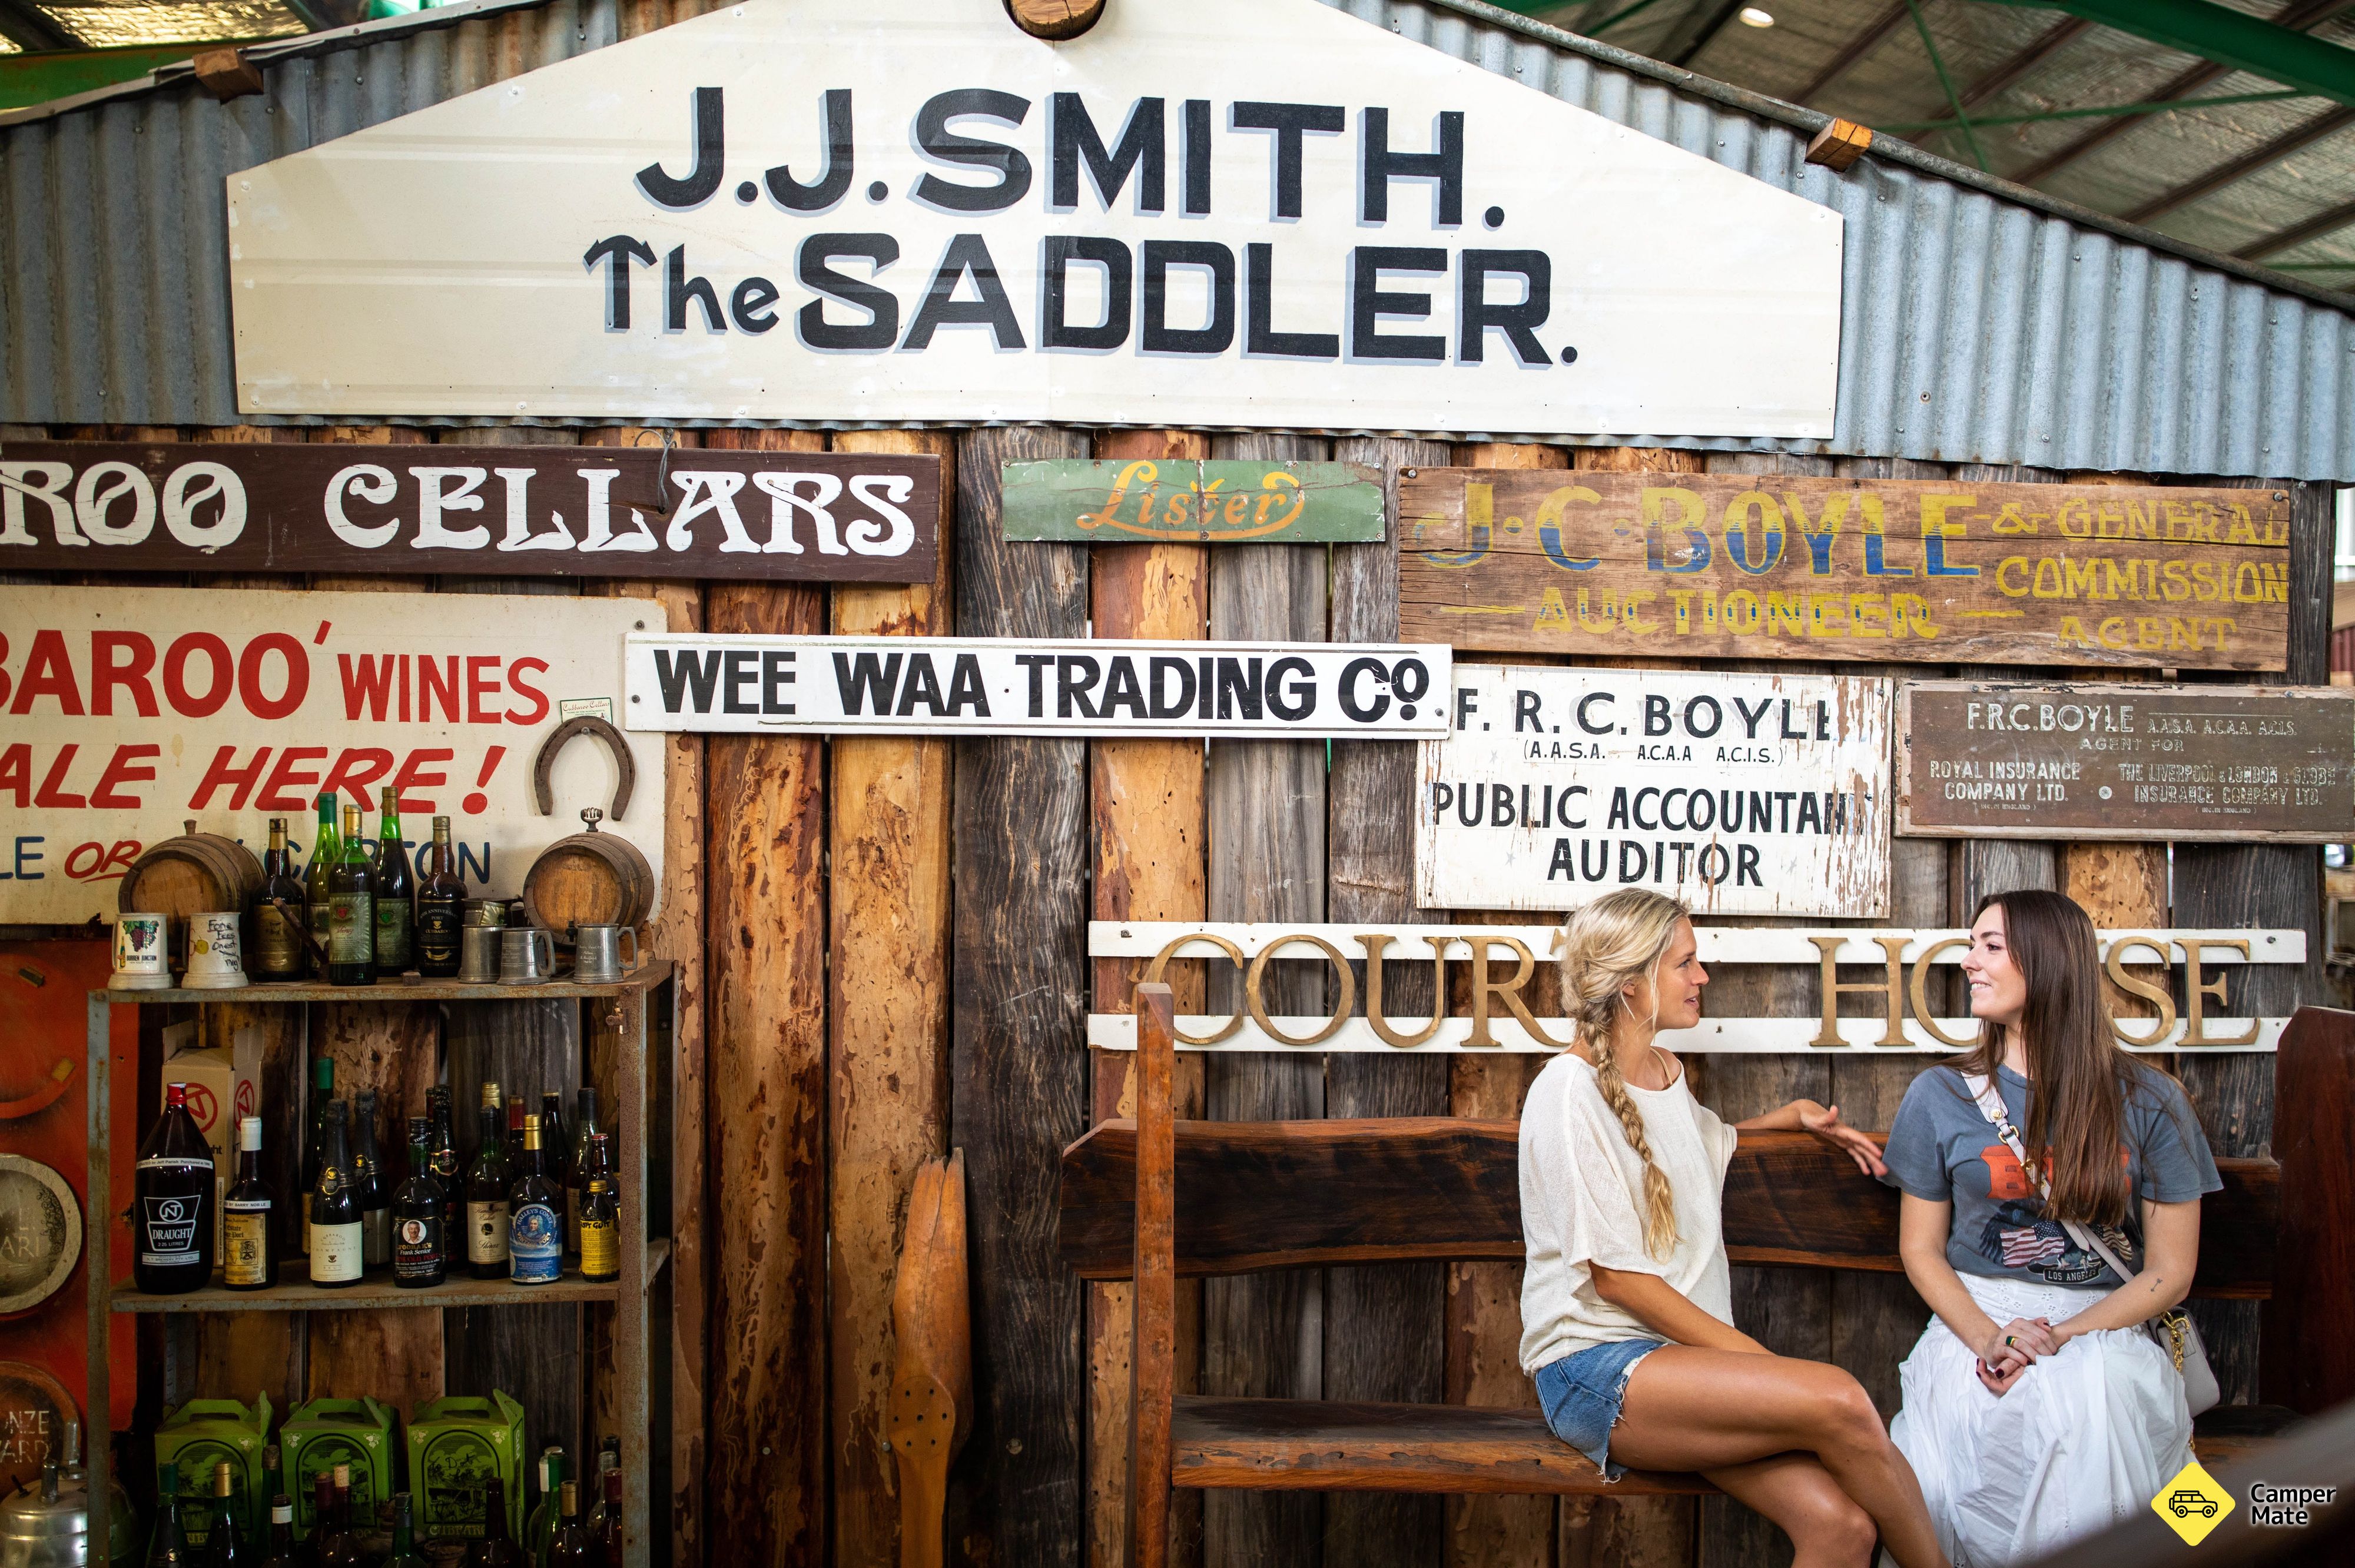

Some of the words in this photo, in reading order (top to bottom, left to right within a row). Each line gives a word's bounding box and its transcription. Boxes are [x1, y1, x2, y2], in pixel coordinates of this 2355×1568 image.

[583, 234, 781, 334] The
[796, 232, 1579, 366] SADDLER.
[324, 463, 915, 557] CELLARS
[1077, 460, 1305, 540] Lister
[2058, 497, 2288, 546] GENERAL
[1996, 556, 2288, 603] COMMISSION
[1532, 586, 1942, 639] AUCTIONEER
[2059, 616, 2237, 652] AGENT
[0, 620, 331, 720] AROO'
[338, 653, 550, 726] WINES
[653, 649, 796, 715] WEE
[831, 652, 991, 717] WAA
[1014, 654, 1317, 720] TRADING
[2079, 738, 2142, 751] AGENT
[2151, 739, 2185, 752] FOR
[1930, 760, 1983, 779] ROYAL
[1989, 761, 2081, 780] INSURANCE
[1944, 782, 2029, 801] COMPANY
[2036, 782, 2069, 802] LTD.
[2118, 763, 2144, 782] THE
[2148, 764, 2216, 783] LIVERPOOL
[2228, 766, 2278, 784] LONDON
[2293, 766, 2336, 787] GLOBE
[1432, 782, 1588, 829] PUBLIC
[1608, 786, 1872, 835] ACCOUNTAN
[2134, 785, 2214, 804] INSURANCE
[2223, 786, 2288, 805] COMPANY
[64, 840, 143, 881] OR
[1547, 837, 1764, 888] AUDITOR
[1145, 933, 1571, 1048] COUR
[1807, 936, 2261, 1047] HOSE
[152, 1228, 191, 1240] DRAUGHT
[539, 1209, 553, 1224] COMET
[2048, 1271, 2062, 1281] LOS
[2066, 1270, 2097, 1281] ANGELES
[4, 1410, 50, 1435] NZE
